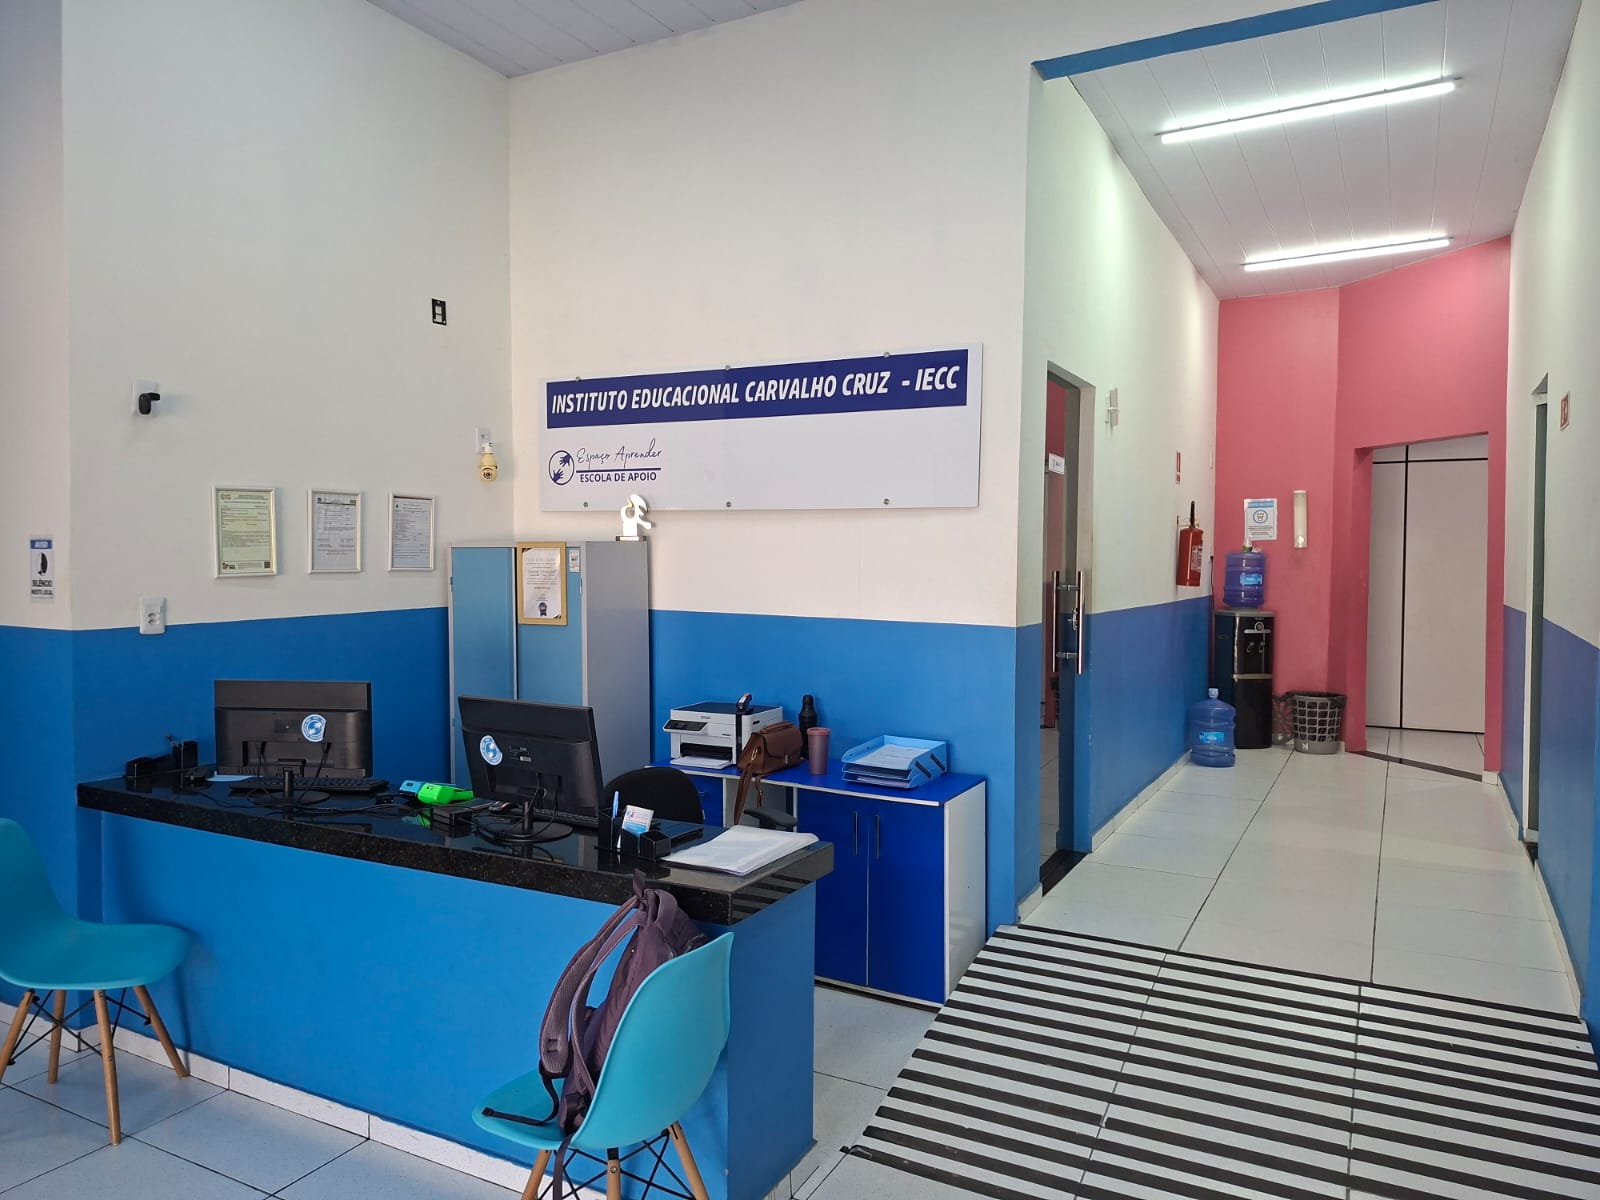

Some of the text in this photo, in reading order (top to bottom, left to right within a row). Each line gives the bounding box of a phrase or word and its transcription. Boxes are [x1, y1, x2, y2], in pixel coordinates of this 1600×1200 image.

[551, 389, 628, 414] INSTITUTO
[631, 382, 740, 409] EDUCACIONAL
[744, 375, 837, 403] CARVALHO
[842, 370, 891, 396] CRUZ
[914, 365, 960, 392] IECC
[576, 437, 662, 470] Espaço Aprender
[580, 471, 657, 483] ESCOLA DE APOIO
